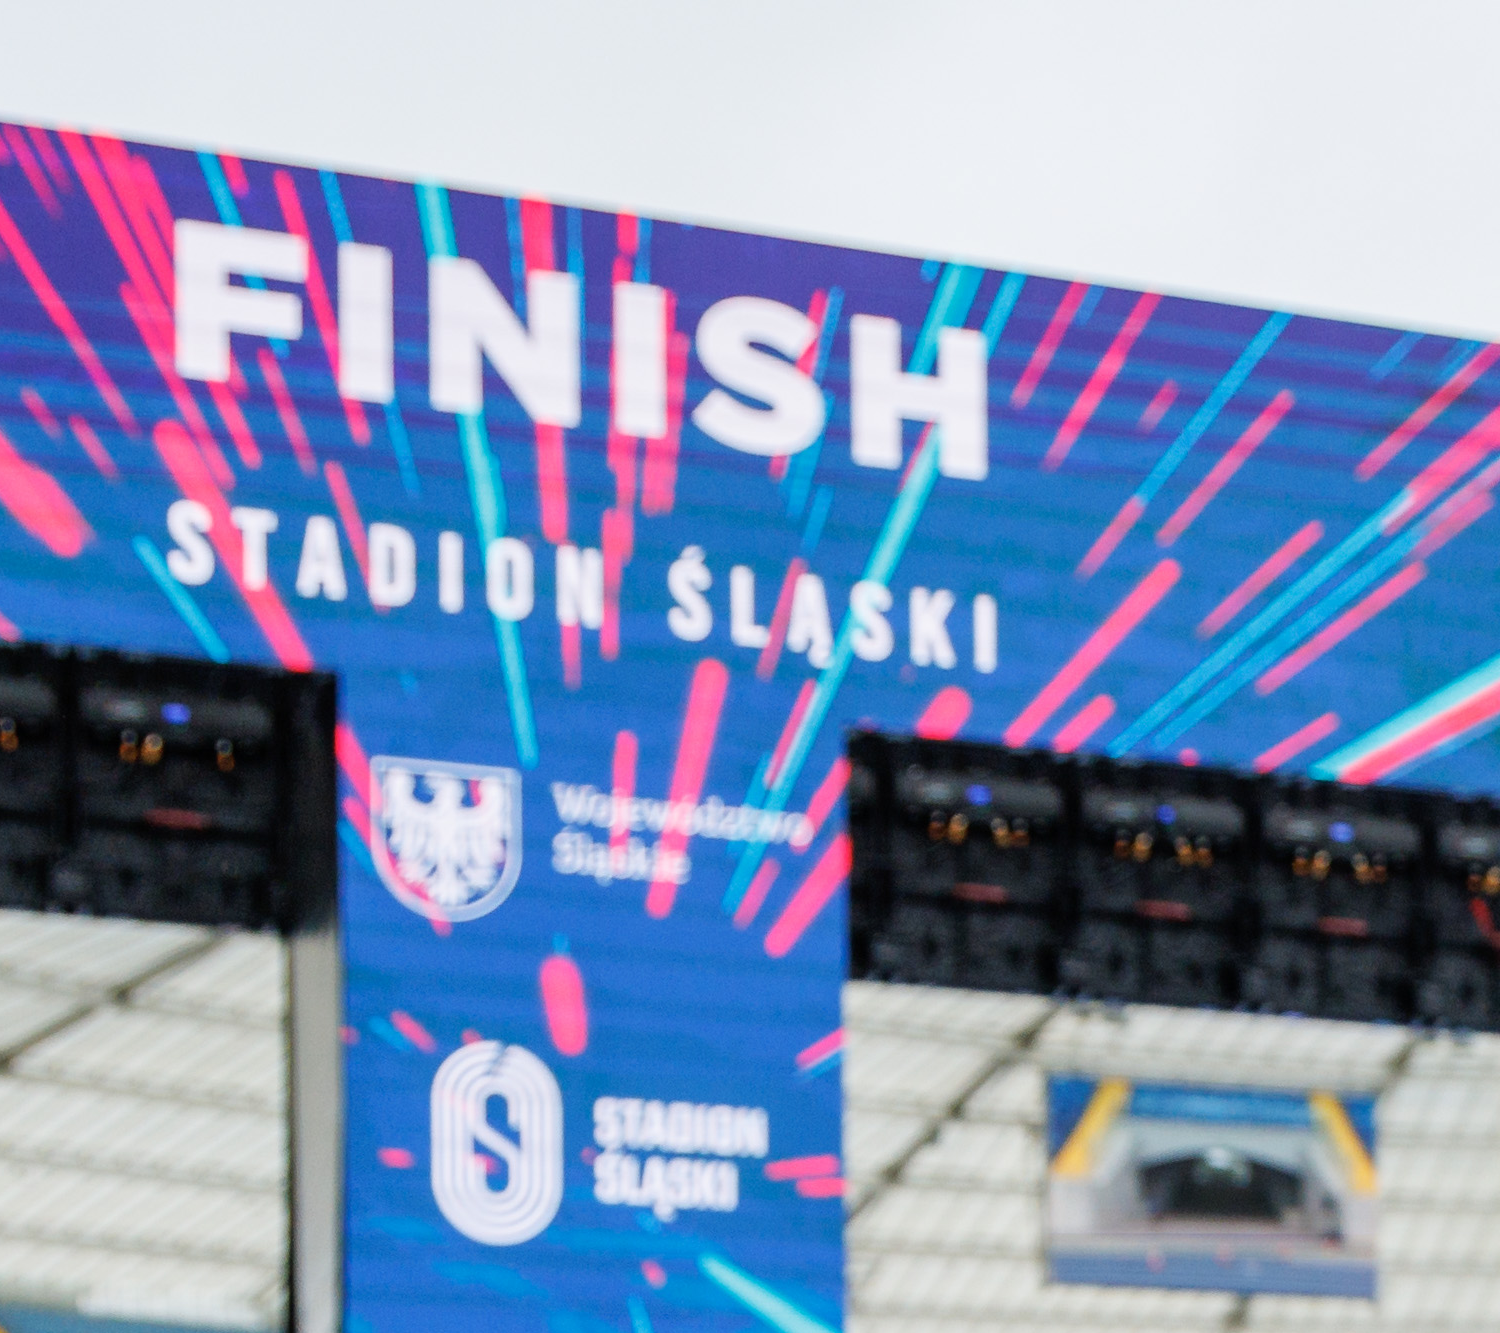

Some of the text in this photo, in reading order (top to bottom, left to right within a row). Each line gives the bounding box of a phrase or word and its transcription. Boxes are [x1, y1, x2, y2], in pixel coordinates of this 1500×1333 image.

[174, 219, 989, 480] FINISH
[166, 498, 998, 674] STADION ŚLĄSKI
[551, 782, 815, 848] Województwo
[592, 1095, 769, 1158] STADION
